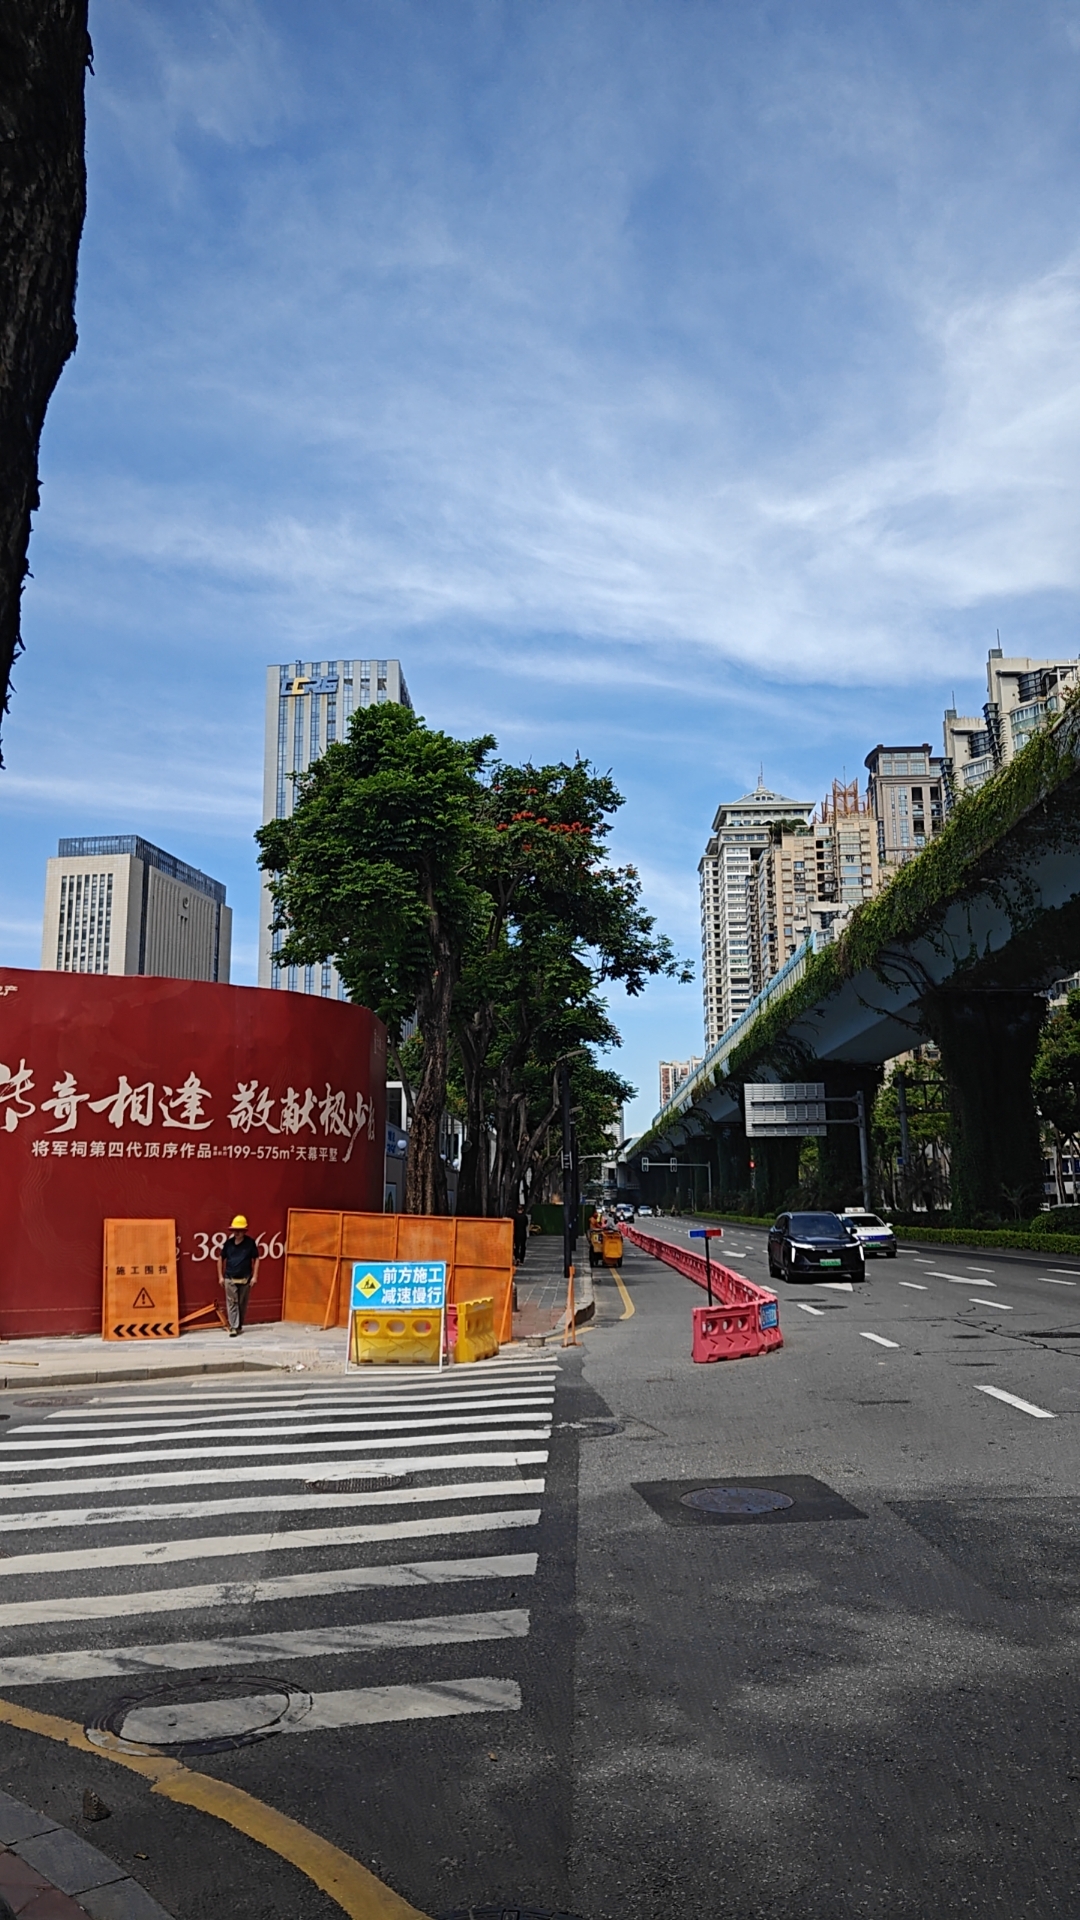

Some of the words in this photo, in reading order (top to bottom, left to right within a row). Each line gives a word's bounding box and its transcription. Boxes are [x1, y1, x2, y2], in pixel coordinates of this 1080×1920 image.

[31, 1140, 212, 1159] 将军祠第四代顶序作品
[116, 1265, 168, 1275] 施工围挡
[383, 1266, 443, 1284] 前方施工
[381, 1286, 442, 1304] 减速慢行
